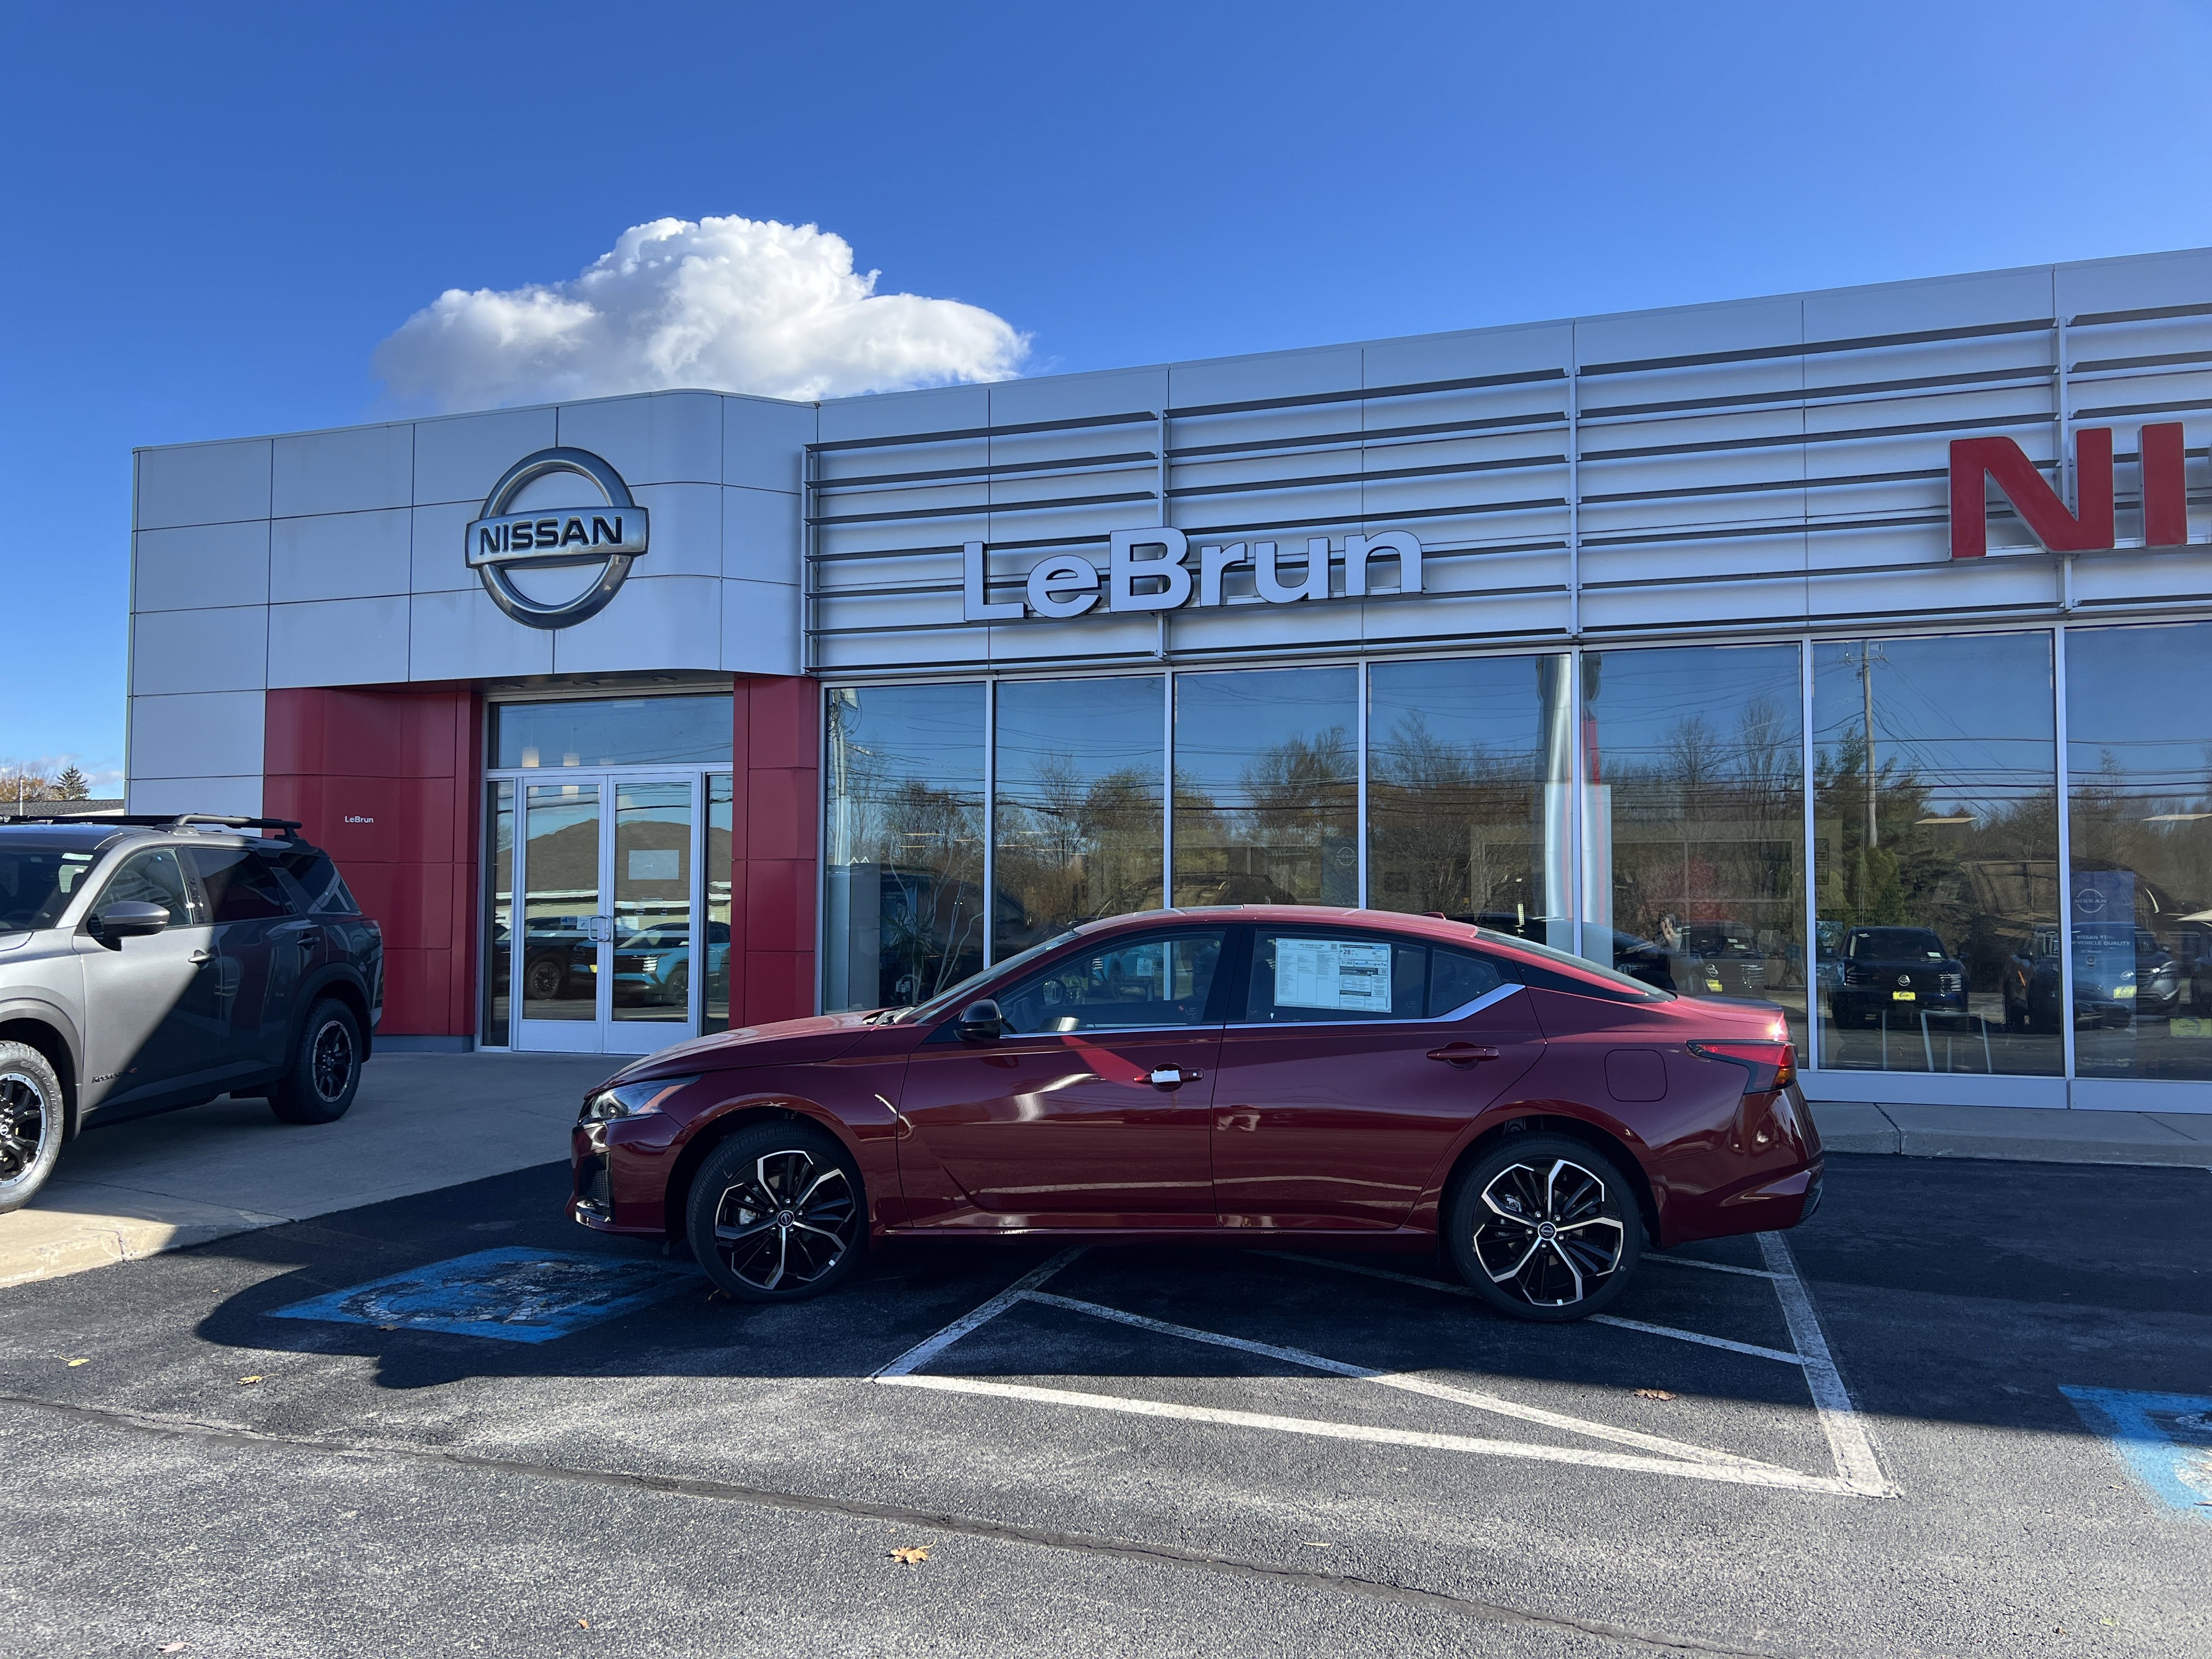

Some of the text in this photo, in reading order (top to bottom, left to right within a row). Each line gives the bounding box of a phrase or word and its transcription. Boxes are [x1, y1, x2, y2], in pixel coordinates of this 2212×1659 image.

[479, 515, 623, 555] NISSAN
[1948, 421, 2212, 561] NI
[963, 526, 1424, 622] LeBrun
